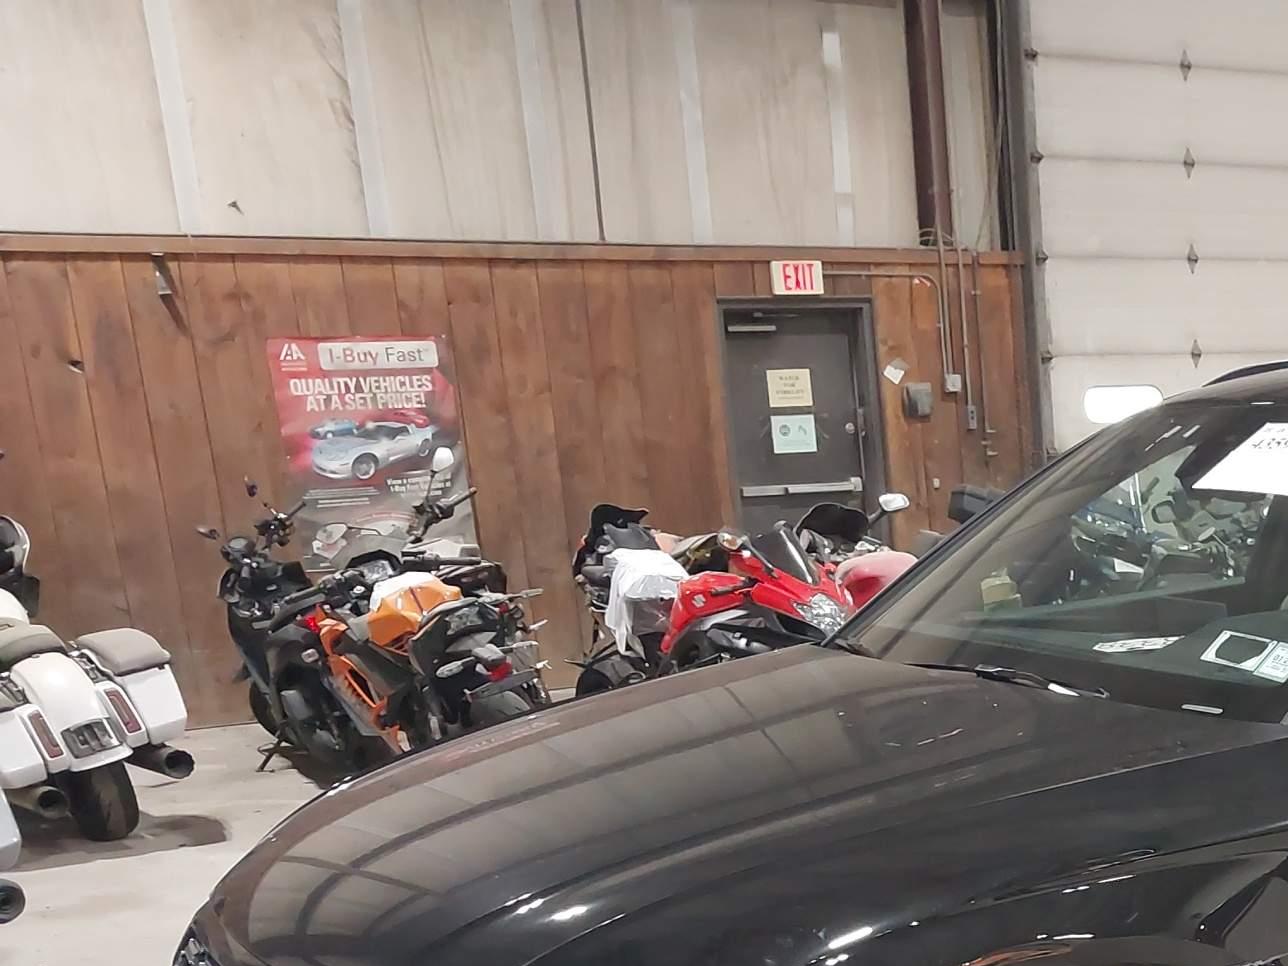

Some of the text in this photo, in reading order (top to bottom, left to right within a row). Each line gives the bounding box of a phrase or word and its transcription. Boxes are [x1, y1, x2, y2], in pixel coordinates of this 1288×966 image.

[782, 263, 815, 291] EXIT
[328, 346, 426, 366] I-Buy Fast
[289, 375, 433, 395] QUALITY VEHICLES
[306, 392, 427, 412] AT A SET PRICE!
